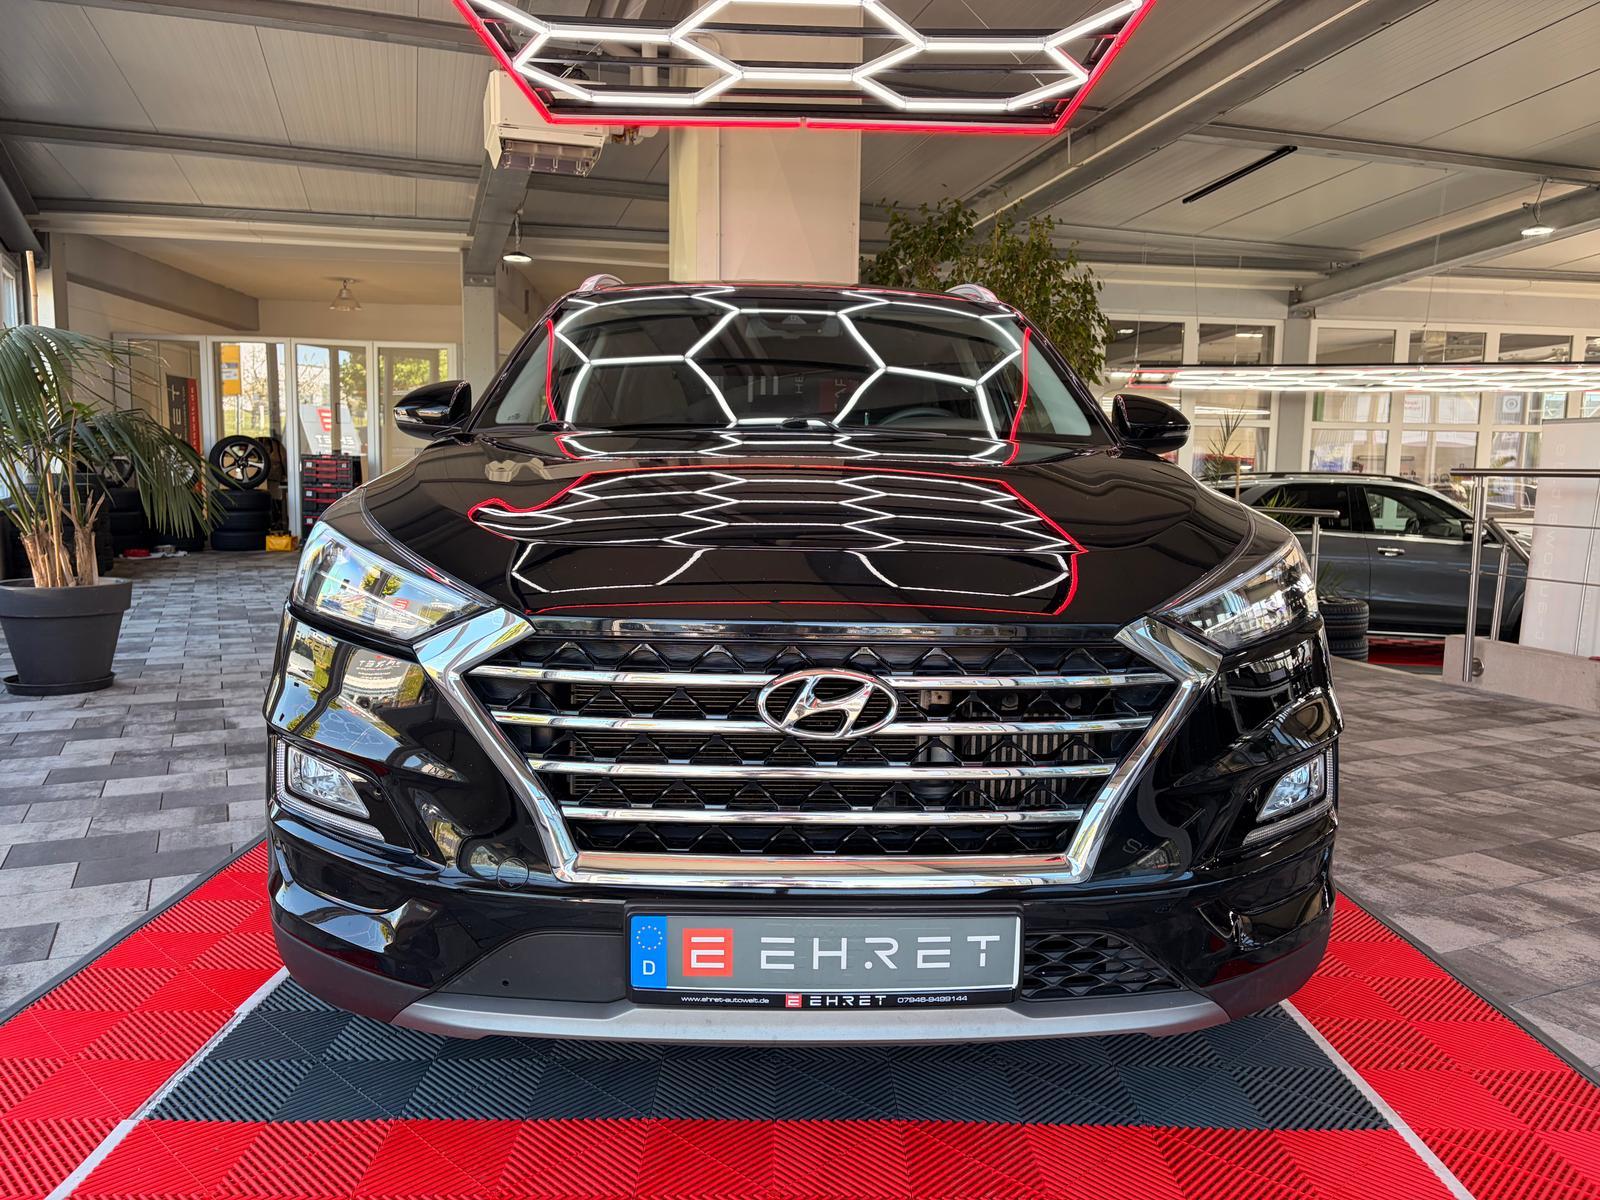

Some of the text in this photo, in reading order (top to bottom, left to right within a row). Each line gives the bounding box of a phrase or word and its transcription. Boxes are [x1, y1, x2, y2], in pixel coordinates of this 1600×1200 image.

[760, 934, 1001, 970] EHRET
[642, 959, 656, 976] D
[680, 996, 770, 1004] www.ehret-autowelt.de
[809, 995, 887, 1006] EHRET
